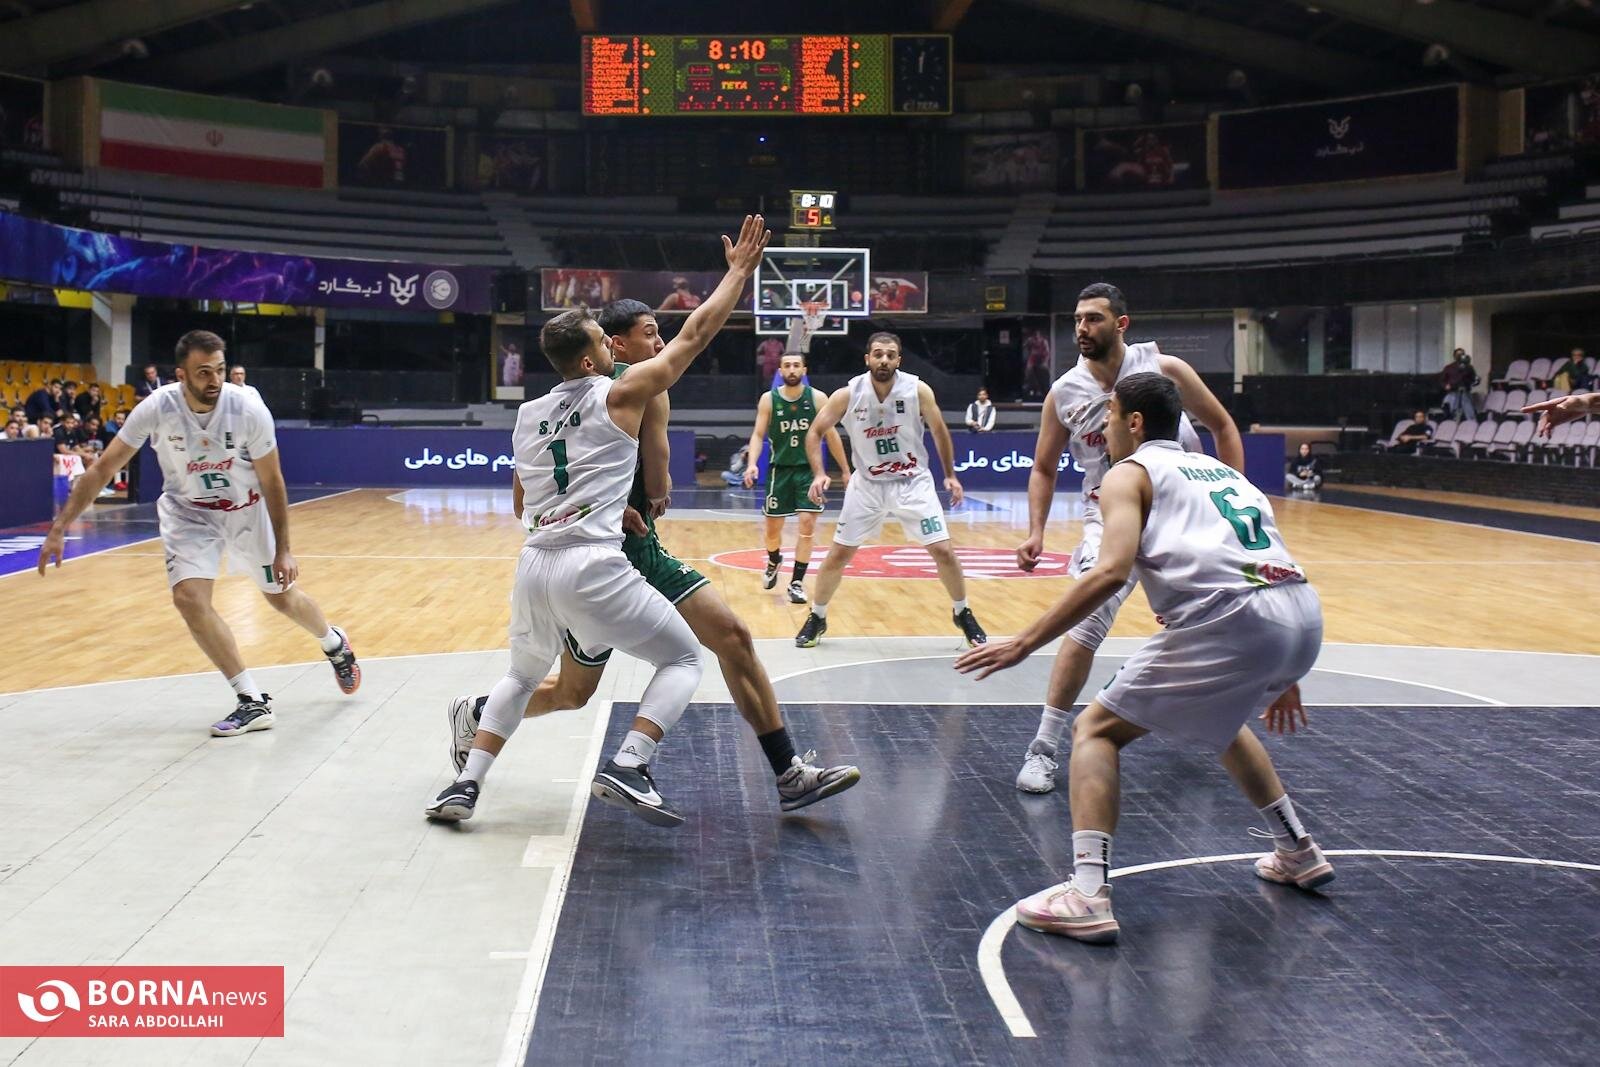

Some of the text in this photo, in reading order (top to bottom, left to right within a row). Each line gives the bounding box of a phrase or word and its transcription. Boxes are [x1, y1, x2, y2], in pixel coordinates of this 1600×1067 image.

[708, 39, 766, 60] 8:10
[721, 80, 748, 90] TETA
[808, 209, 819, 225] 5
[780, 418, 809, 433] PAS
[789, 435, 799, 447] 6
[875, 437, 900, 455] 86
[404, 448, 444, 470] ملی
[446, 448, 489, 470] های
[547, 438, 569, 495] 1
[953, 450, 989, 472] ملی
[992, 450, 1034, 472] های
[200, 472, 231, 490] 15
[768, 496, 779, 509] 6
[920, 515, 943, 536] 86
[1209, 486, 1271, 551] 6
